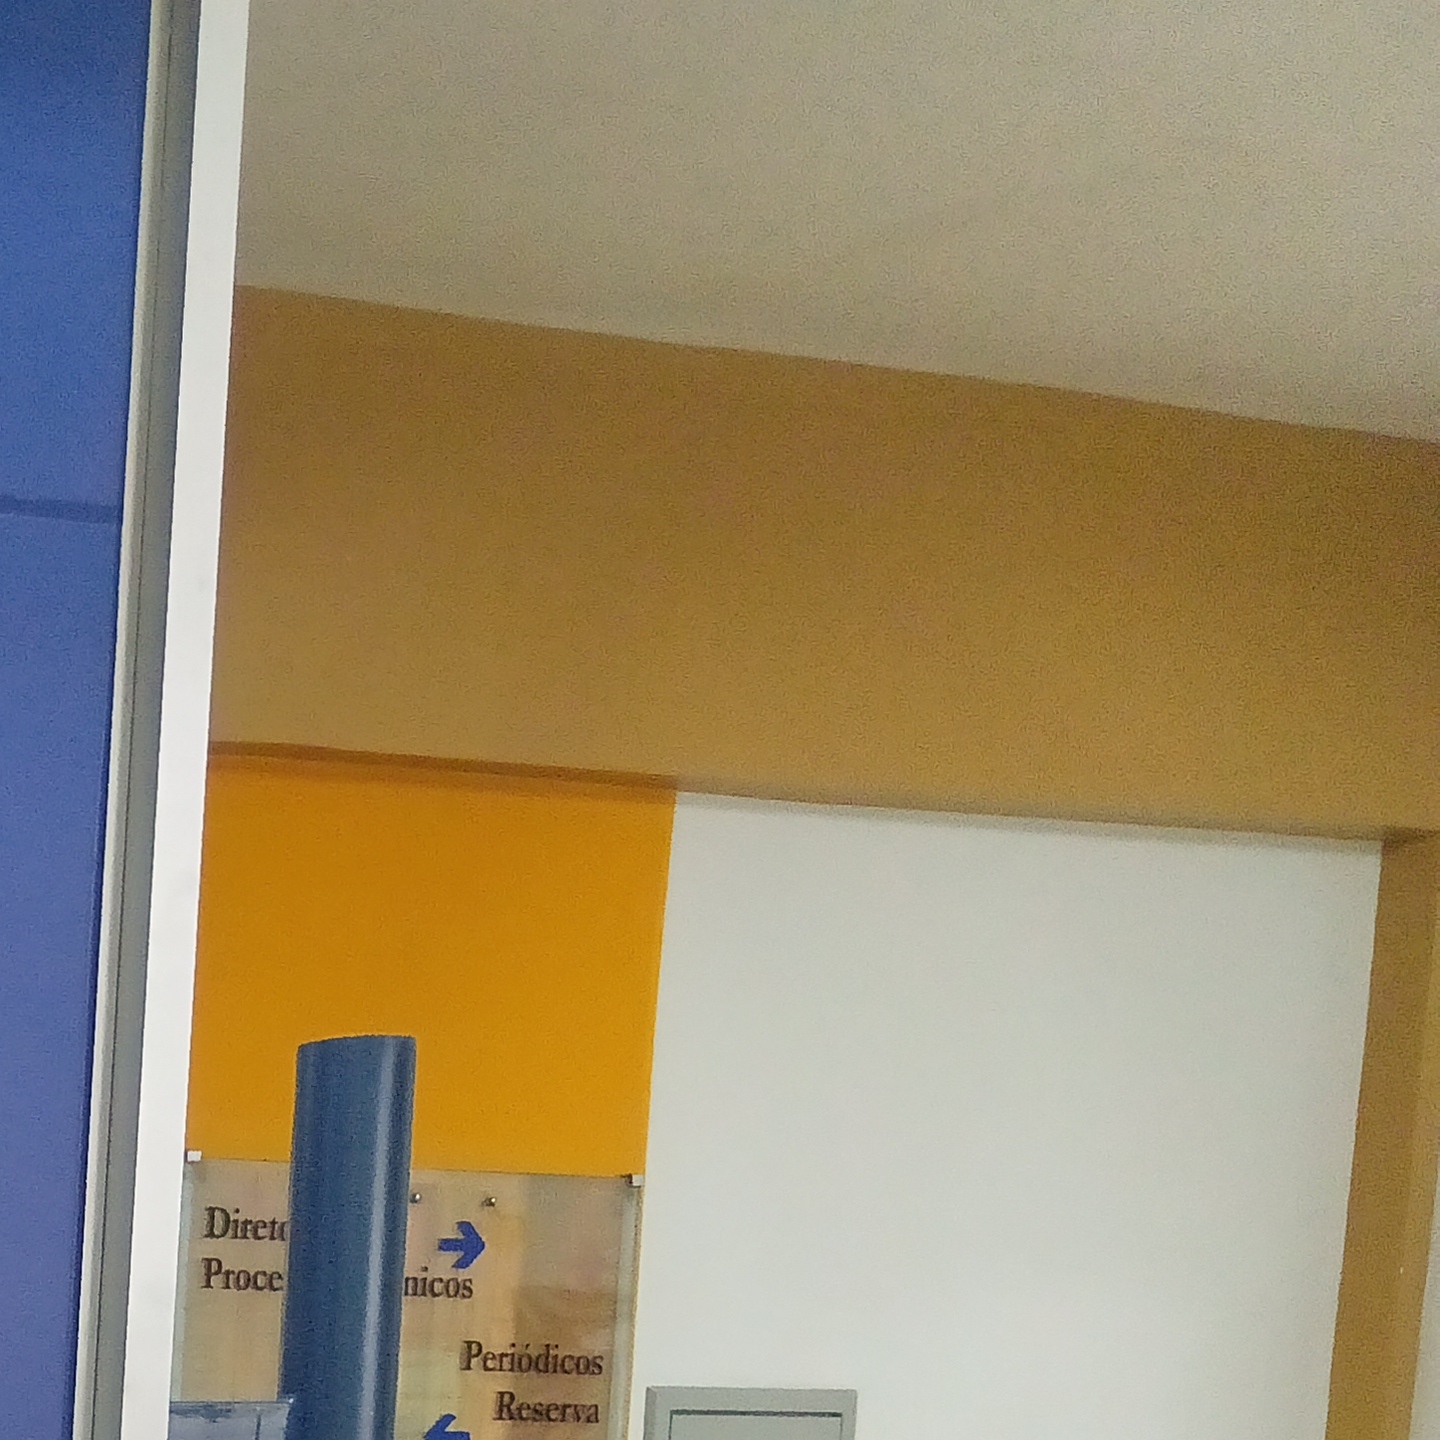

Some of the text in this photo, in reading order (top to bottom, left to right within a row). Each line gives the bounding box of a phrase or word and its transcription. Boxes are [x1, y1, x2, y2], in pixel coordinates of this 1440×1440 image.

[200, 1256, 474, 1300] Proce nicos
[459, 1339, 604, 1377] Periódicos
[491, 1390, 600, 1425] Reserva
